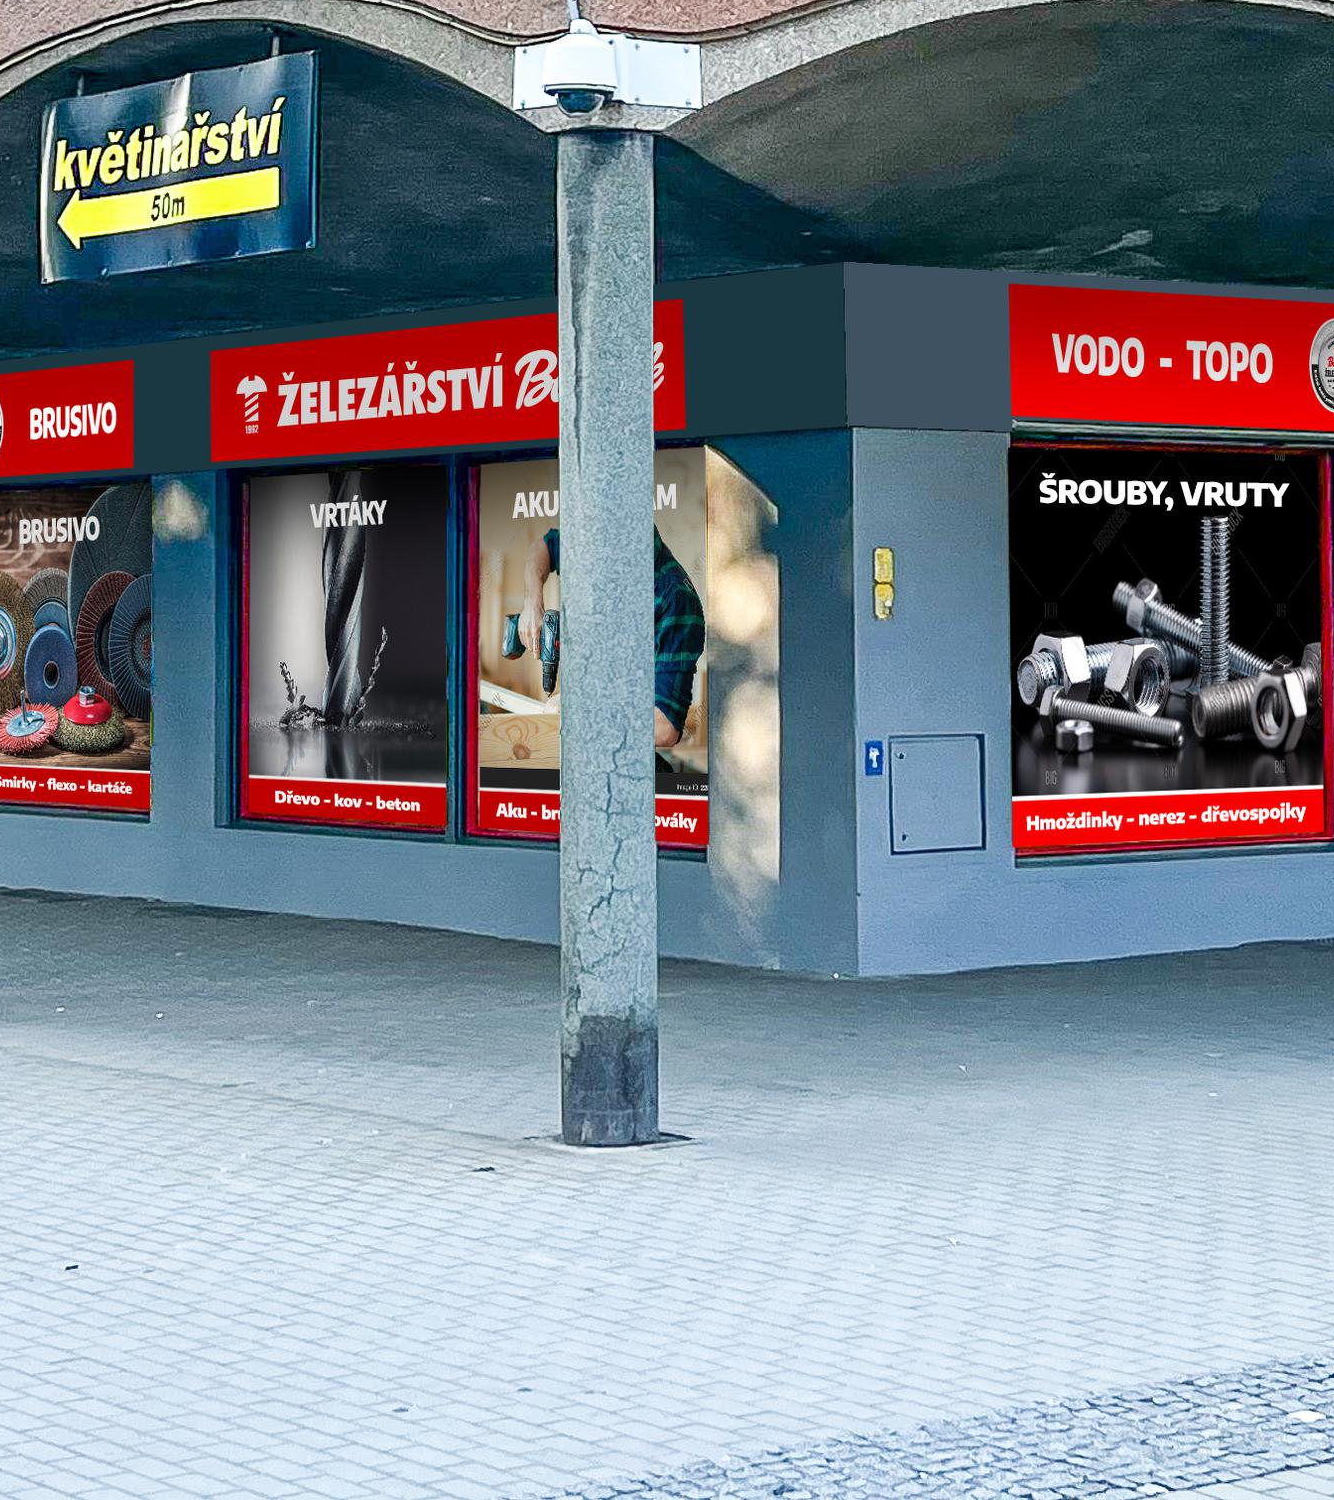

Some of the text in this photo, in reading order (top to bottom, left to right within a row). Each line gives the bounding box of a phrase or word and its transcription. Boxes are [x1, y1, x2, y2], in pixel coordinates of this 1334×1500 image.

[53, 97, 286, 192] květinářství
[151, 192, 186, 222] 50m
[1051, 332, 1145, 377] VODO
[1186, 340, 1274, 384] TOPO
[276, 352, 503, 427] ŽELEZÁŘSTVÍ
[29, 401, 117, 441] BRUSIVO
[512, 490, 559, 518] AKU
[1039, 472, 1290, 510] ŠROUBY, VRUTY
[310, 495, 387, 530] VRTÁKY
[19, 515, 100, 545] BRUSIVO
[47, 778, 77, 791] flexo
[88, 780, 133, 795] kartáče
[275, 790, 320, 808] Dřevo
[334, 794, 362, 808] kov
[376, 796, 420, 812] beton
[496, 802, 527, 819] Aku
[1026, 810, 1123, 831] Hmoždinky
[1139, 810, 1185, 826] nerez
[1201, 802, 1307, 823] dřevospojky
